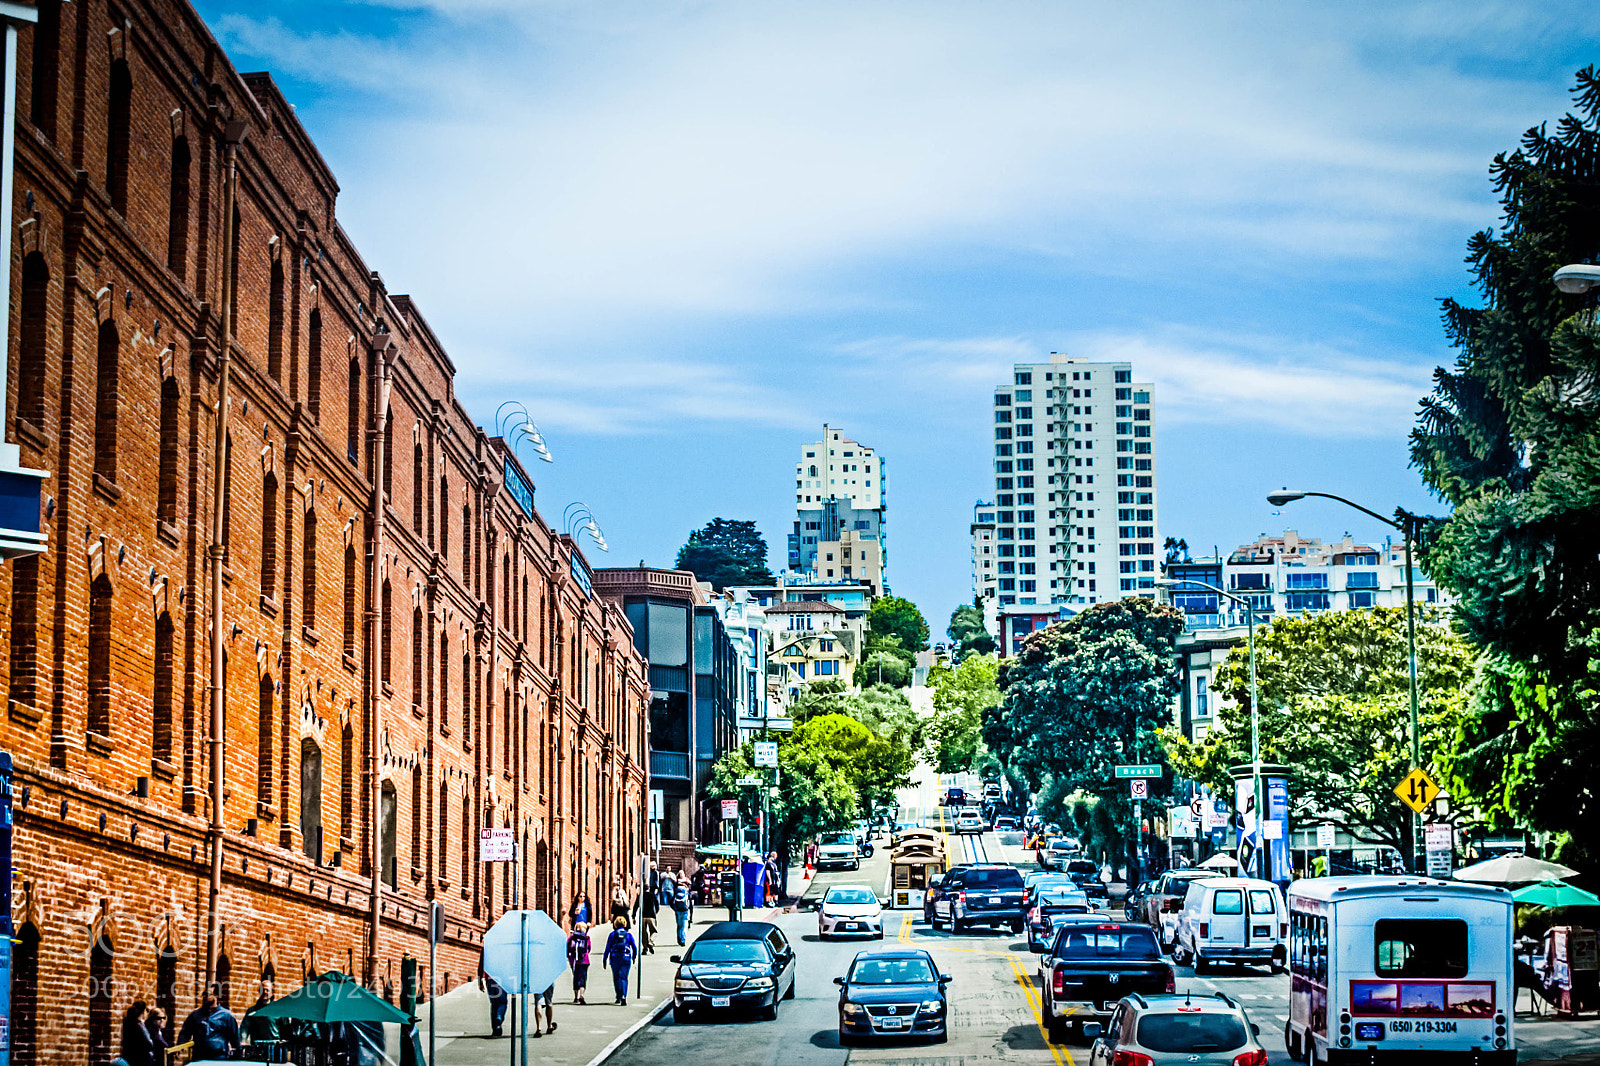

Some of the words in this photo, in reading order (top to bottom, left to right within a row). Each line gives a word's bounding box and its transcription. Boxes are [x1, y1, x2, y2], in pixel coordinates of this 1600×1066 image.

[482, 830, 491, 838] NO
[1389, 1021, 1413, 1033] (650)
[1415, 1021, 1458, 1034] 219-3304
